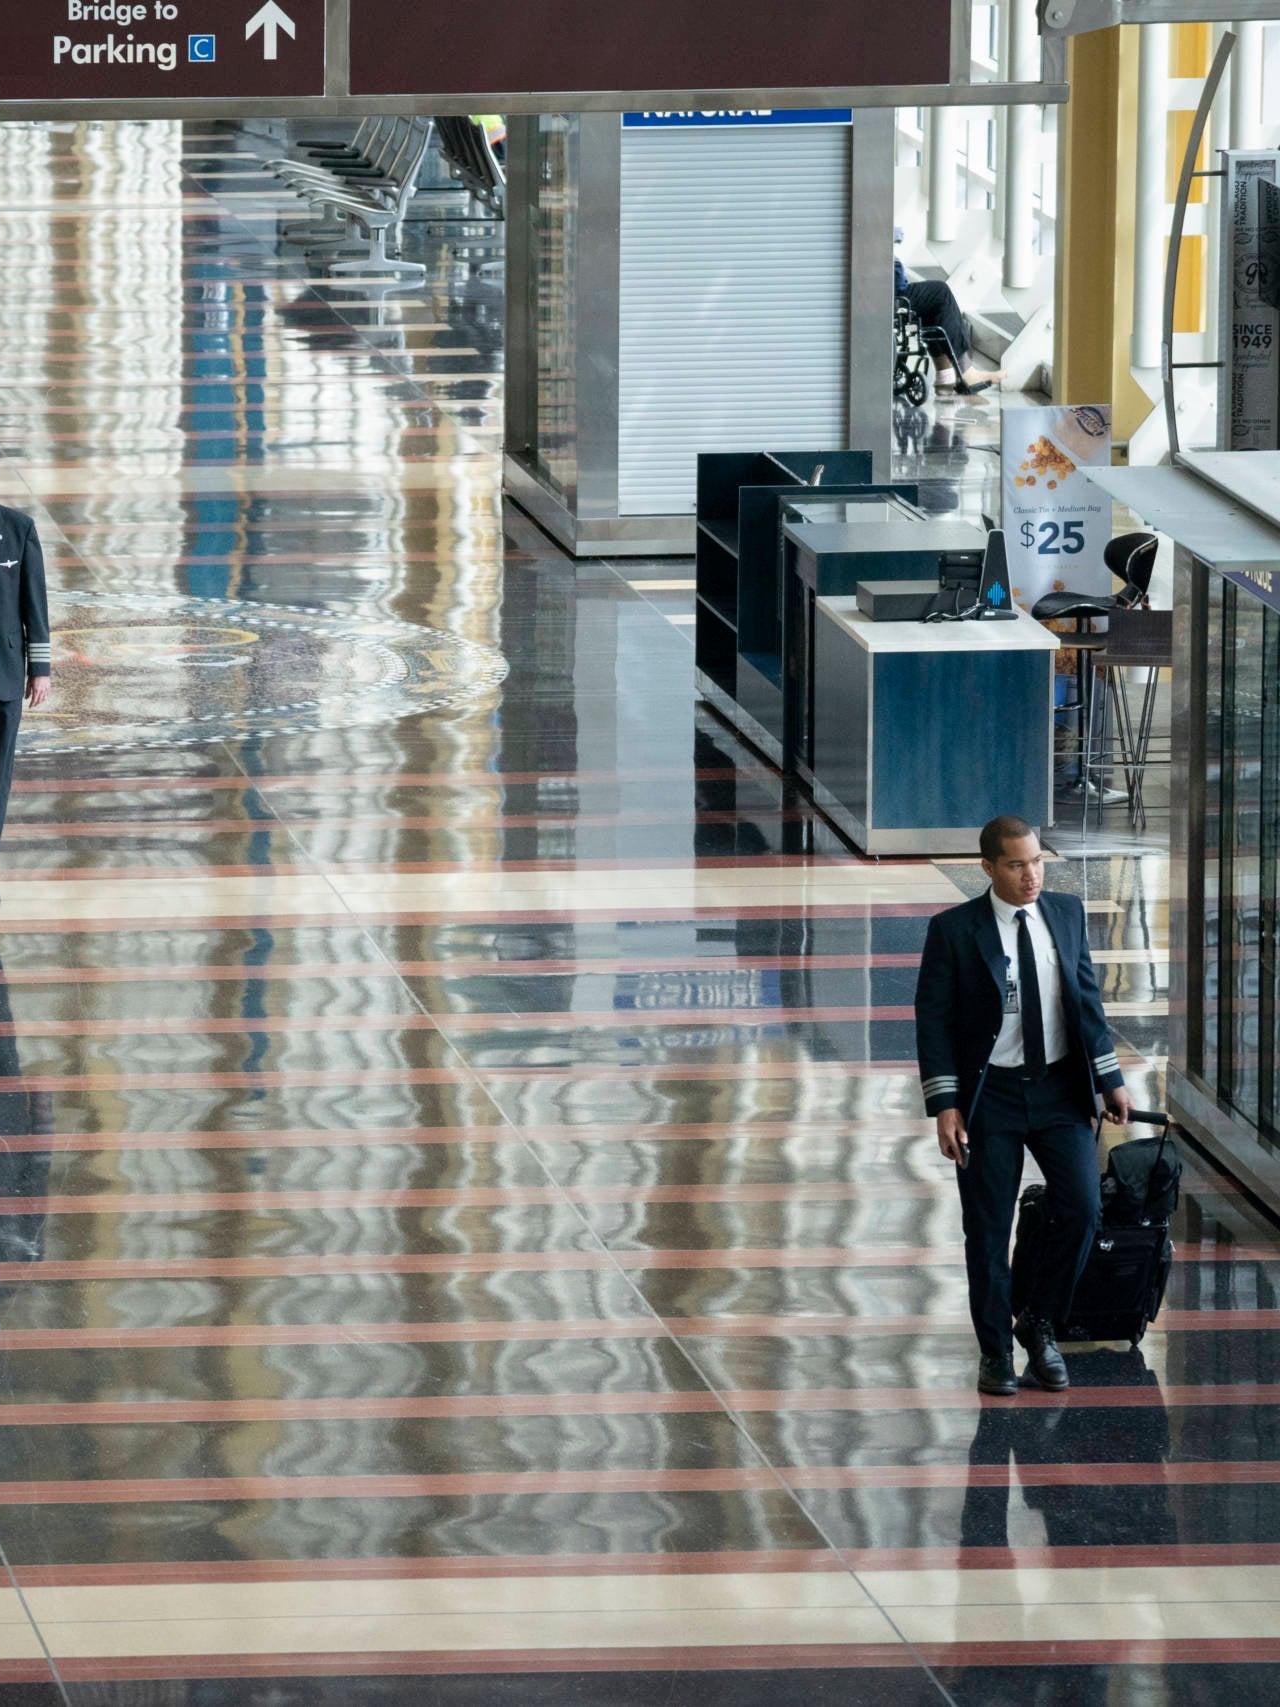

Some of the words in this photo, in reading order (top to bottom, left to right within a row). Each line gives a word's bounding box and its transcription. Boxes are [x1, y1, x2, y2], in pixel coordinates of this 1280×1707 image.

[68, 0, 147, 26] Bridge
[154, 2, 178, 20] to
[53, 34, 177, 71] Parking
[194, 38, 209, 58] C
[1239, 181, 1247, 226] TRADITION
[1232, 324, 1272, 335] SINCE
[1232, 335, 1272, 349] 1949
[1013, 504, 1036, 514] Classic
[1057, 505, 1086, 513] Medium
[1087, 504, 1102, 514] Bag
[1020, 520, 1085, 555] $25
